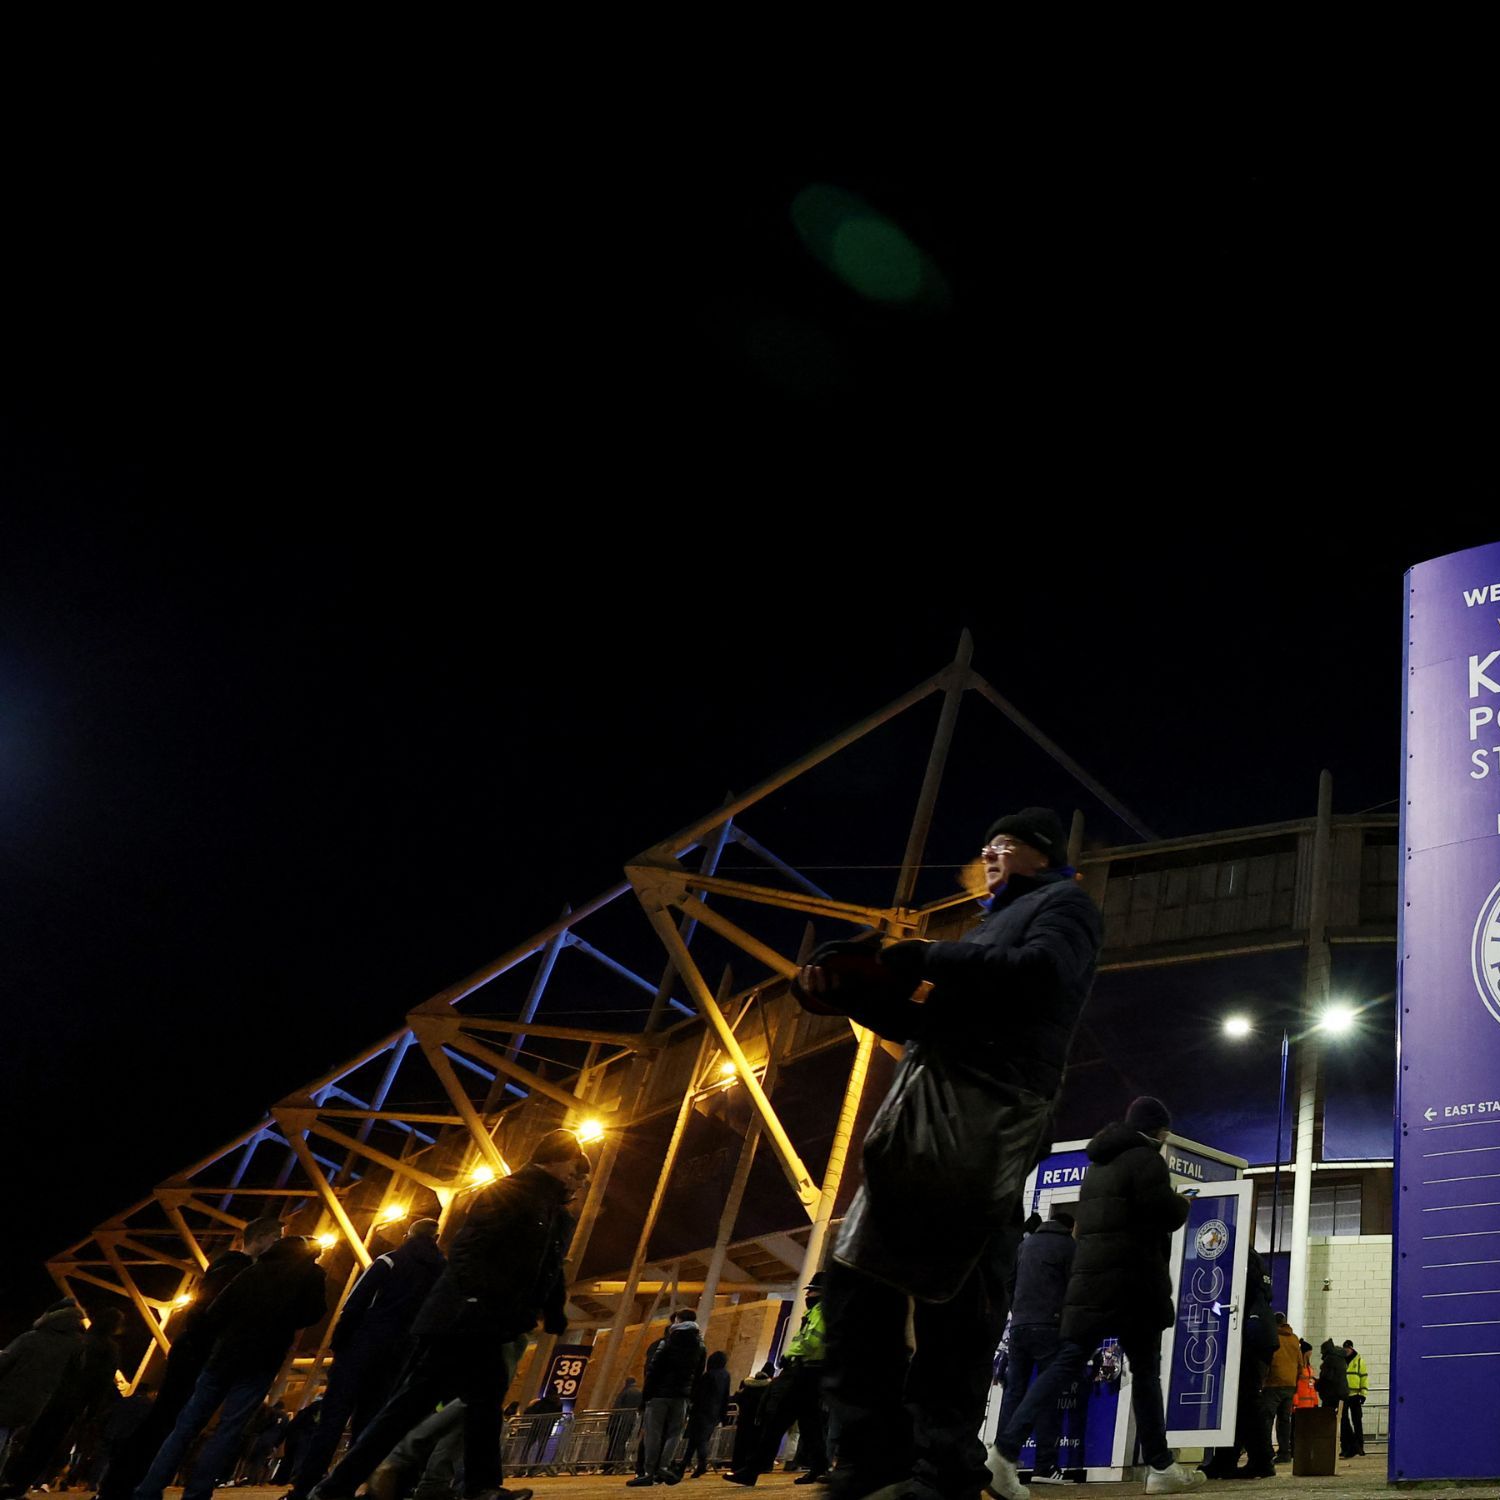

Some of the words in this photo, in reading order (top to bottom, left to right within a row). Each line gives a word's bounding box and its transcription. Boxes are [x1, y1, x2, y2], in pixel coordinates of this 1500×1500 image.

[1444, 1104, 1475, 1117] EAST
[1043, 1166, 1089, 1185] RETAI
[1169, 1155, 1204, 1179] RETAIL
[1180, 1266, 1225, 1405] LCFC
[556, 1360, 582, 1376] 38
[553, 1379, 577, 1395] 39
